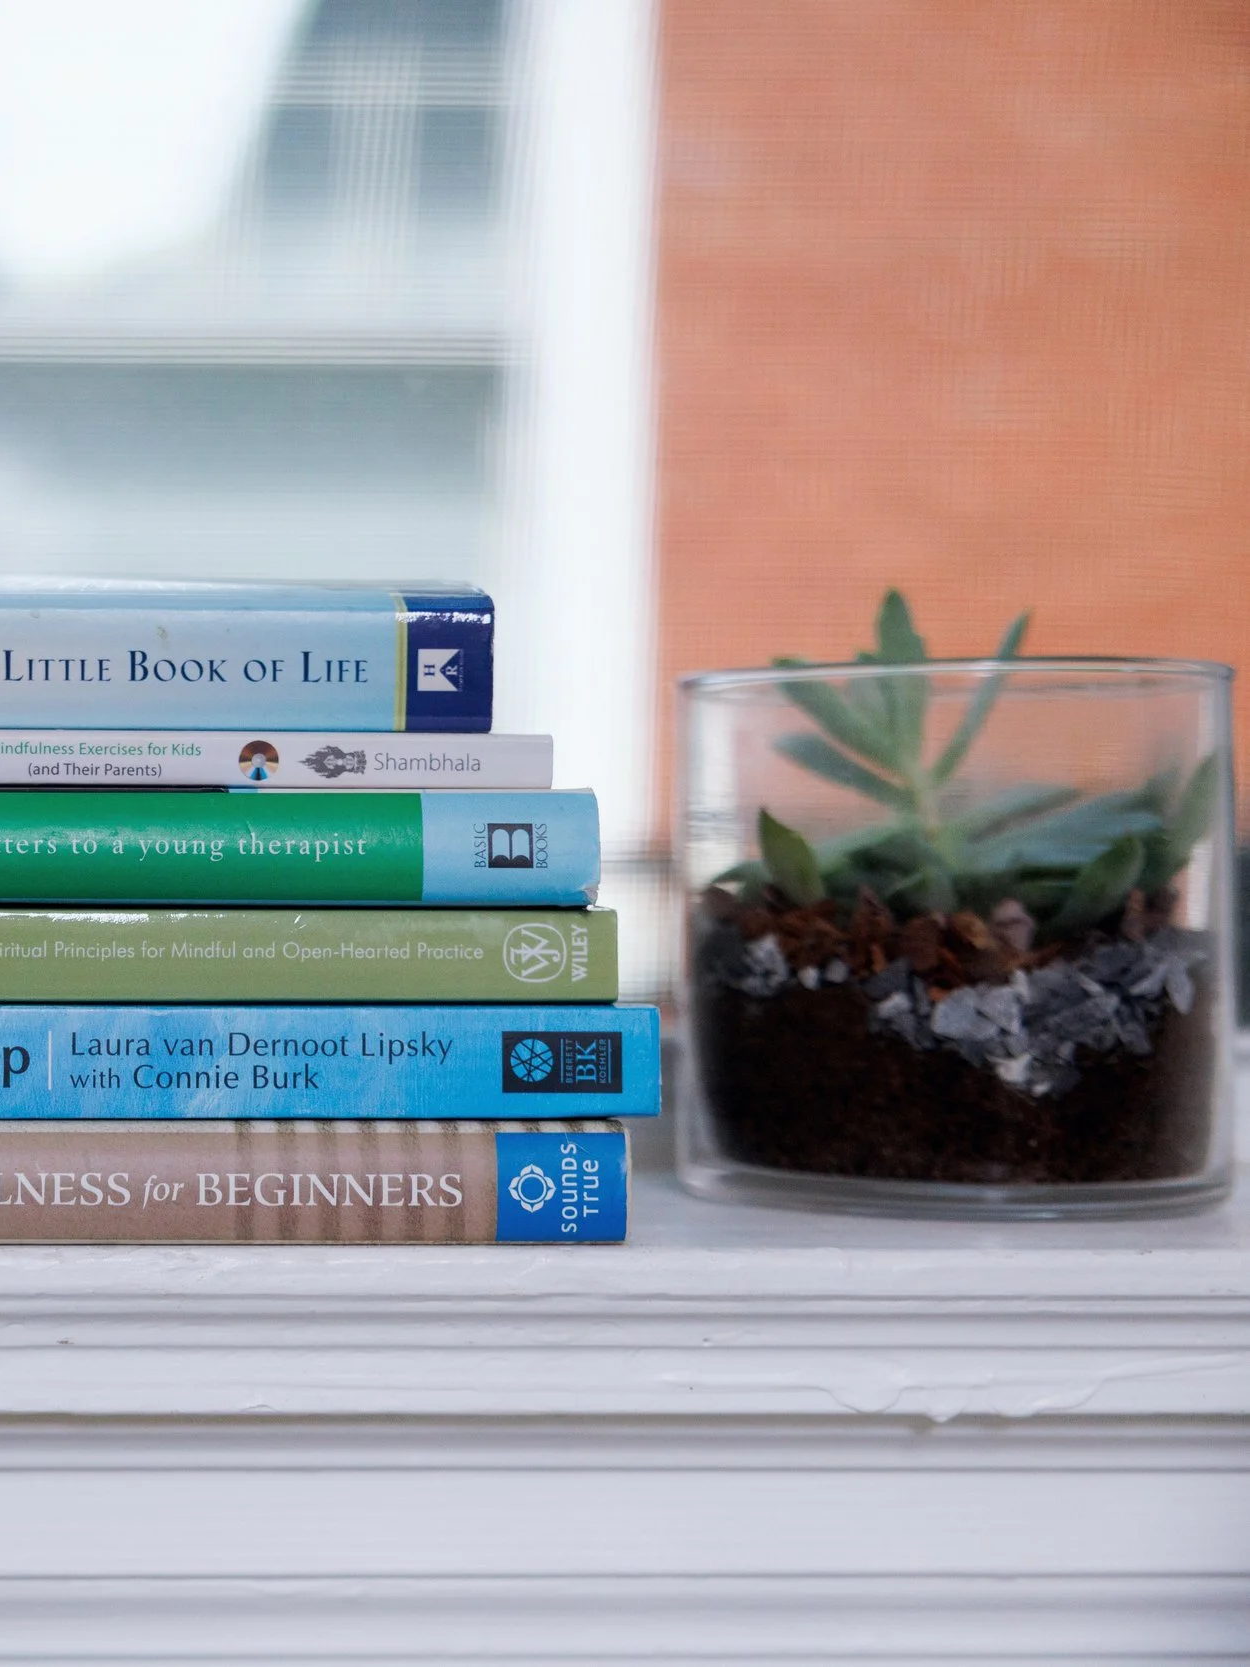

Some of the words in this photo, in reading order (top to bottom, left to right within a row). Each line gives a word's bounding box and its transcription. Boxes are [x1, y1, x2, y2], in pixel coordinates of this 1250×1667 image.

[3, 650, 111, 682] LITTLE
[128, 649, 228, 683] BOOK
[244, 658, 285, 683] OF
[301, 650, 368, 683] LIFE
[78, 742, 144, 756] Exercises
[147, 742, 169, 756] for
[172, 742, 202, 757] Kids
[374, 752, 481, 772] Shambhala
[28, 762, 61, 778] (and
[65, 762, 99, 777] Their
[103, 762, 162, 778] Parents)
[71, 834, 99, 855] to
[112, 838, 124, 855] a
[139, 837, 225, 861] young
[238, 832, 367, 861] therapist
[474, 823, 486, 868] BASIC
[536, 823, 548, 868] BOOKS
[54, 941, 135, 960] Principles
[139, 941, 167, 960] for
[172, 941, 237, 960] Mindful
[243, 941, 276, 960] and
[282, 942, 410, 962] Open-Hearted
[417, 942, 484, 962] Practice
[571, 924, 588, 982] WILEY
[71, 1032, 150, 1057] Laura
[165, 1037, 214, 1057] van
[228, 1032, 350, 1057] Dernoot
[360, 1032, 453, 1065] Lipsky
[575, 1040, 597, 1083] BK
[599, 1039, 607, 1083] KOEHLER
[70, 1068, 120, 1090] with
[133, 1066, 239, 1090] Connie
[251, 1066, 318, 1090] Burk
[143, 1179, 184, 1210] for
[196, 1173, 463, 1208] BEGINNERS
